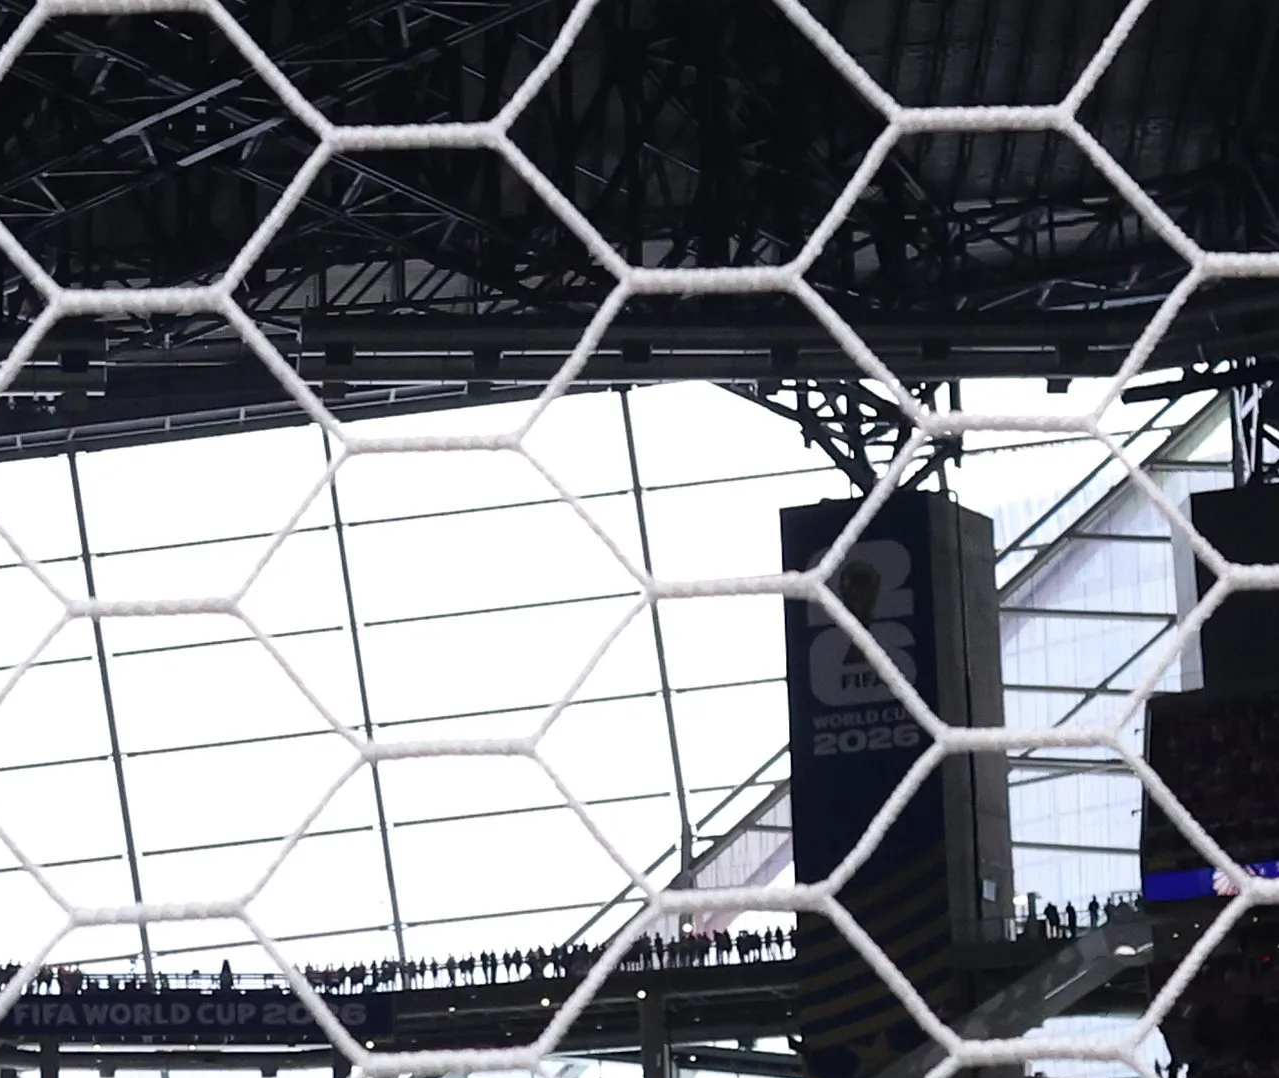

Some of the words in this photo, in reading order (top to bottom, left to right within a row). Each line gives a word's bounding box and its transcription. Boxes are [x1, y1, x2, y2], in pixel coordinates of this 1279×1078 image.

[813, 713, 879, 731] WORLD
[881, 707, 908, 722] CU
[813, 723, 920, 756] 2026
[13, 1003, 77, 1025] FIFA
[80, 1003, 191, 1026] WORLD
[196, 1003, 257, 1025] CUP
[261, 1003, 367, 1026] 206
